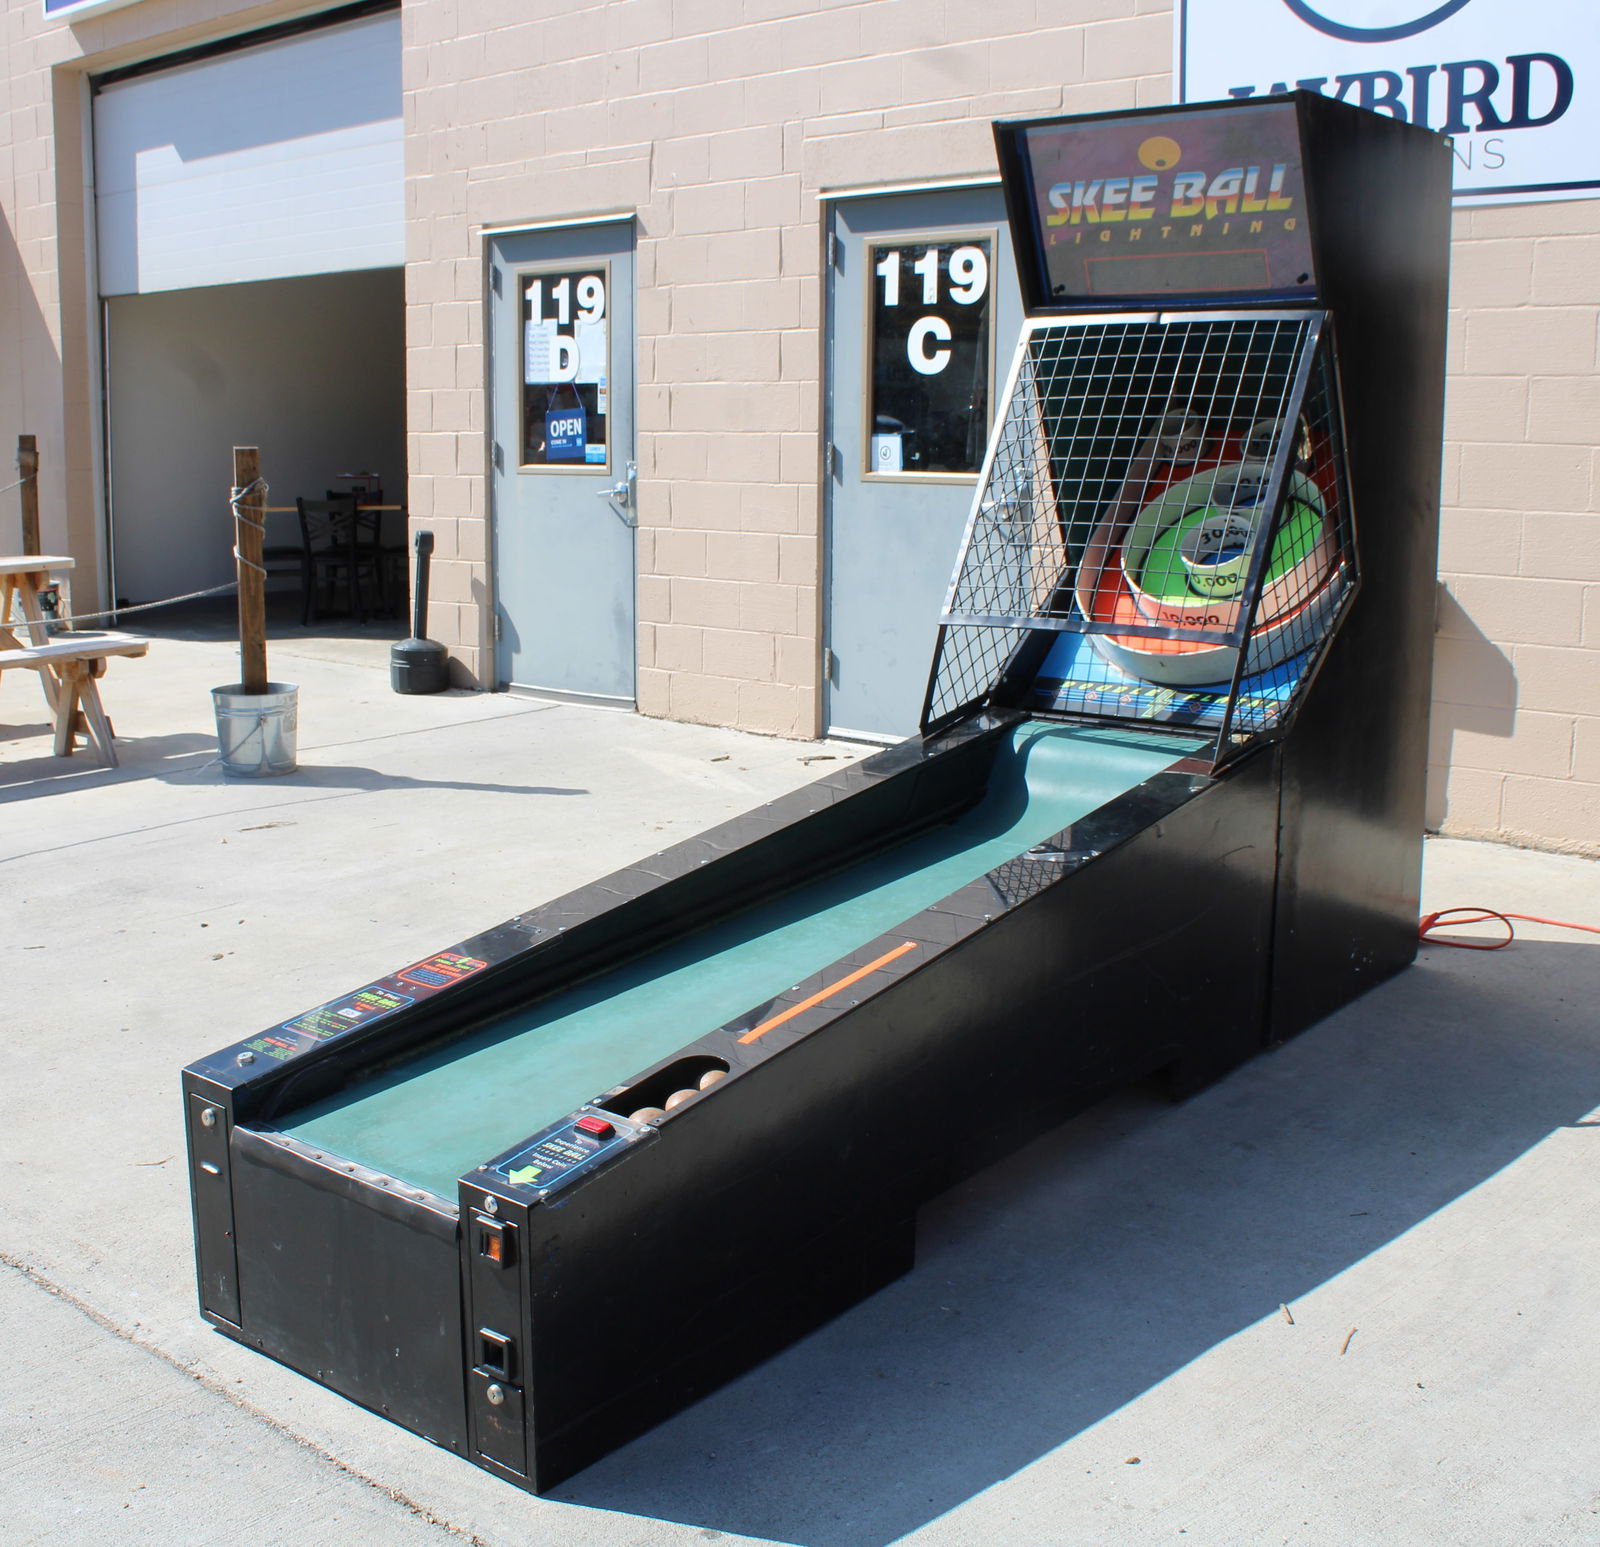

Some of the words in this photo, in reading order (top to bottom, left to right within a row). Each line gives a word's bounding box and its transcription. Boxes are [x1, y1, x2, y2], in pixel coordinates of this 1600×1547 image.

[1229, 52, 1574, 135] BIRD
[1047, 175, 1158, 226] SKEE
[1170, 163, 1293, 220] BALL
[525, 275, 605, 325] 119
[876, 245, 988, 306] 119
[549, 334, 580, 382] D
[907, 315, 952, 376] C
[551, 418, 582, 437] OPEN
